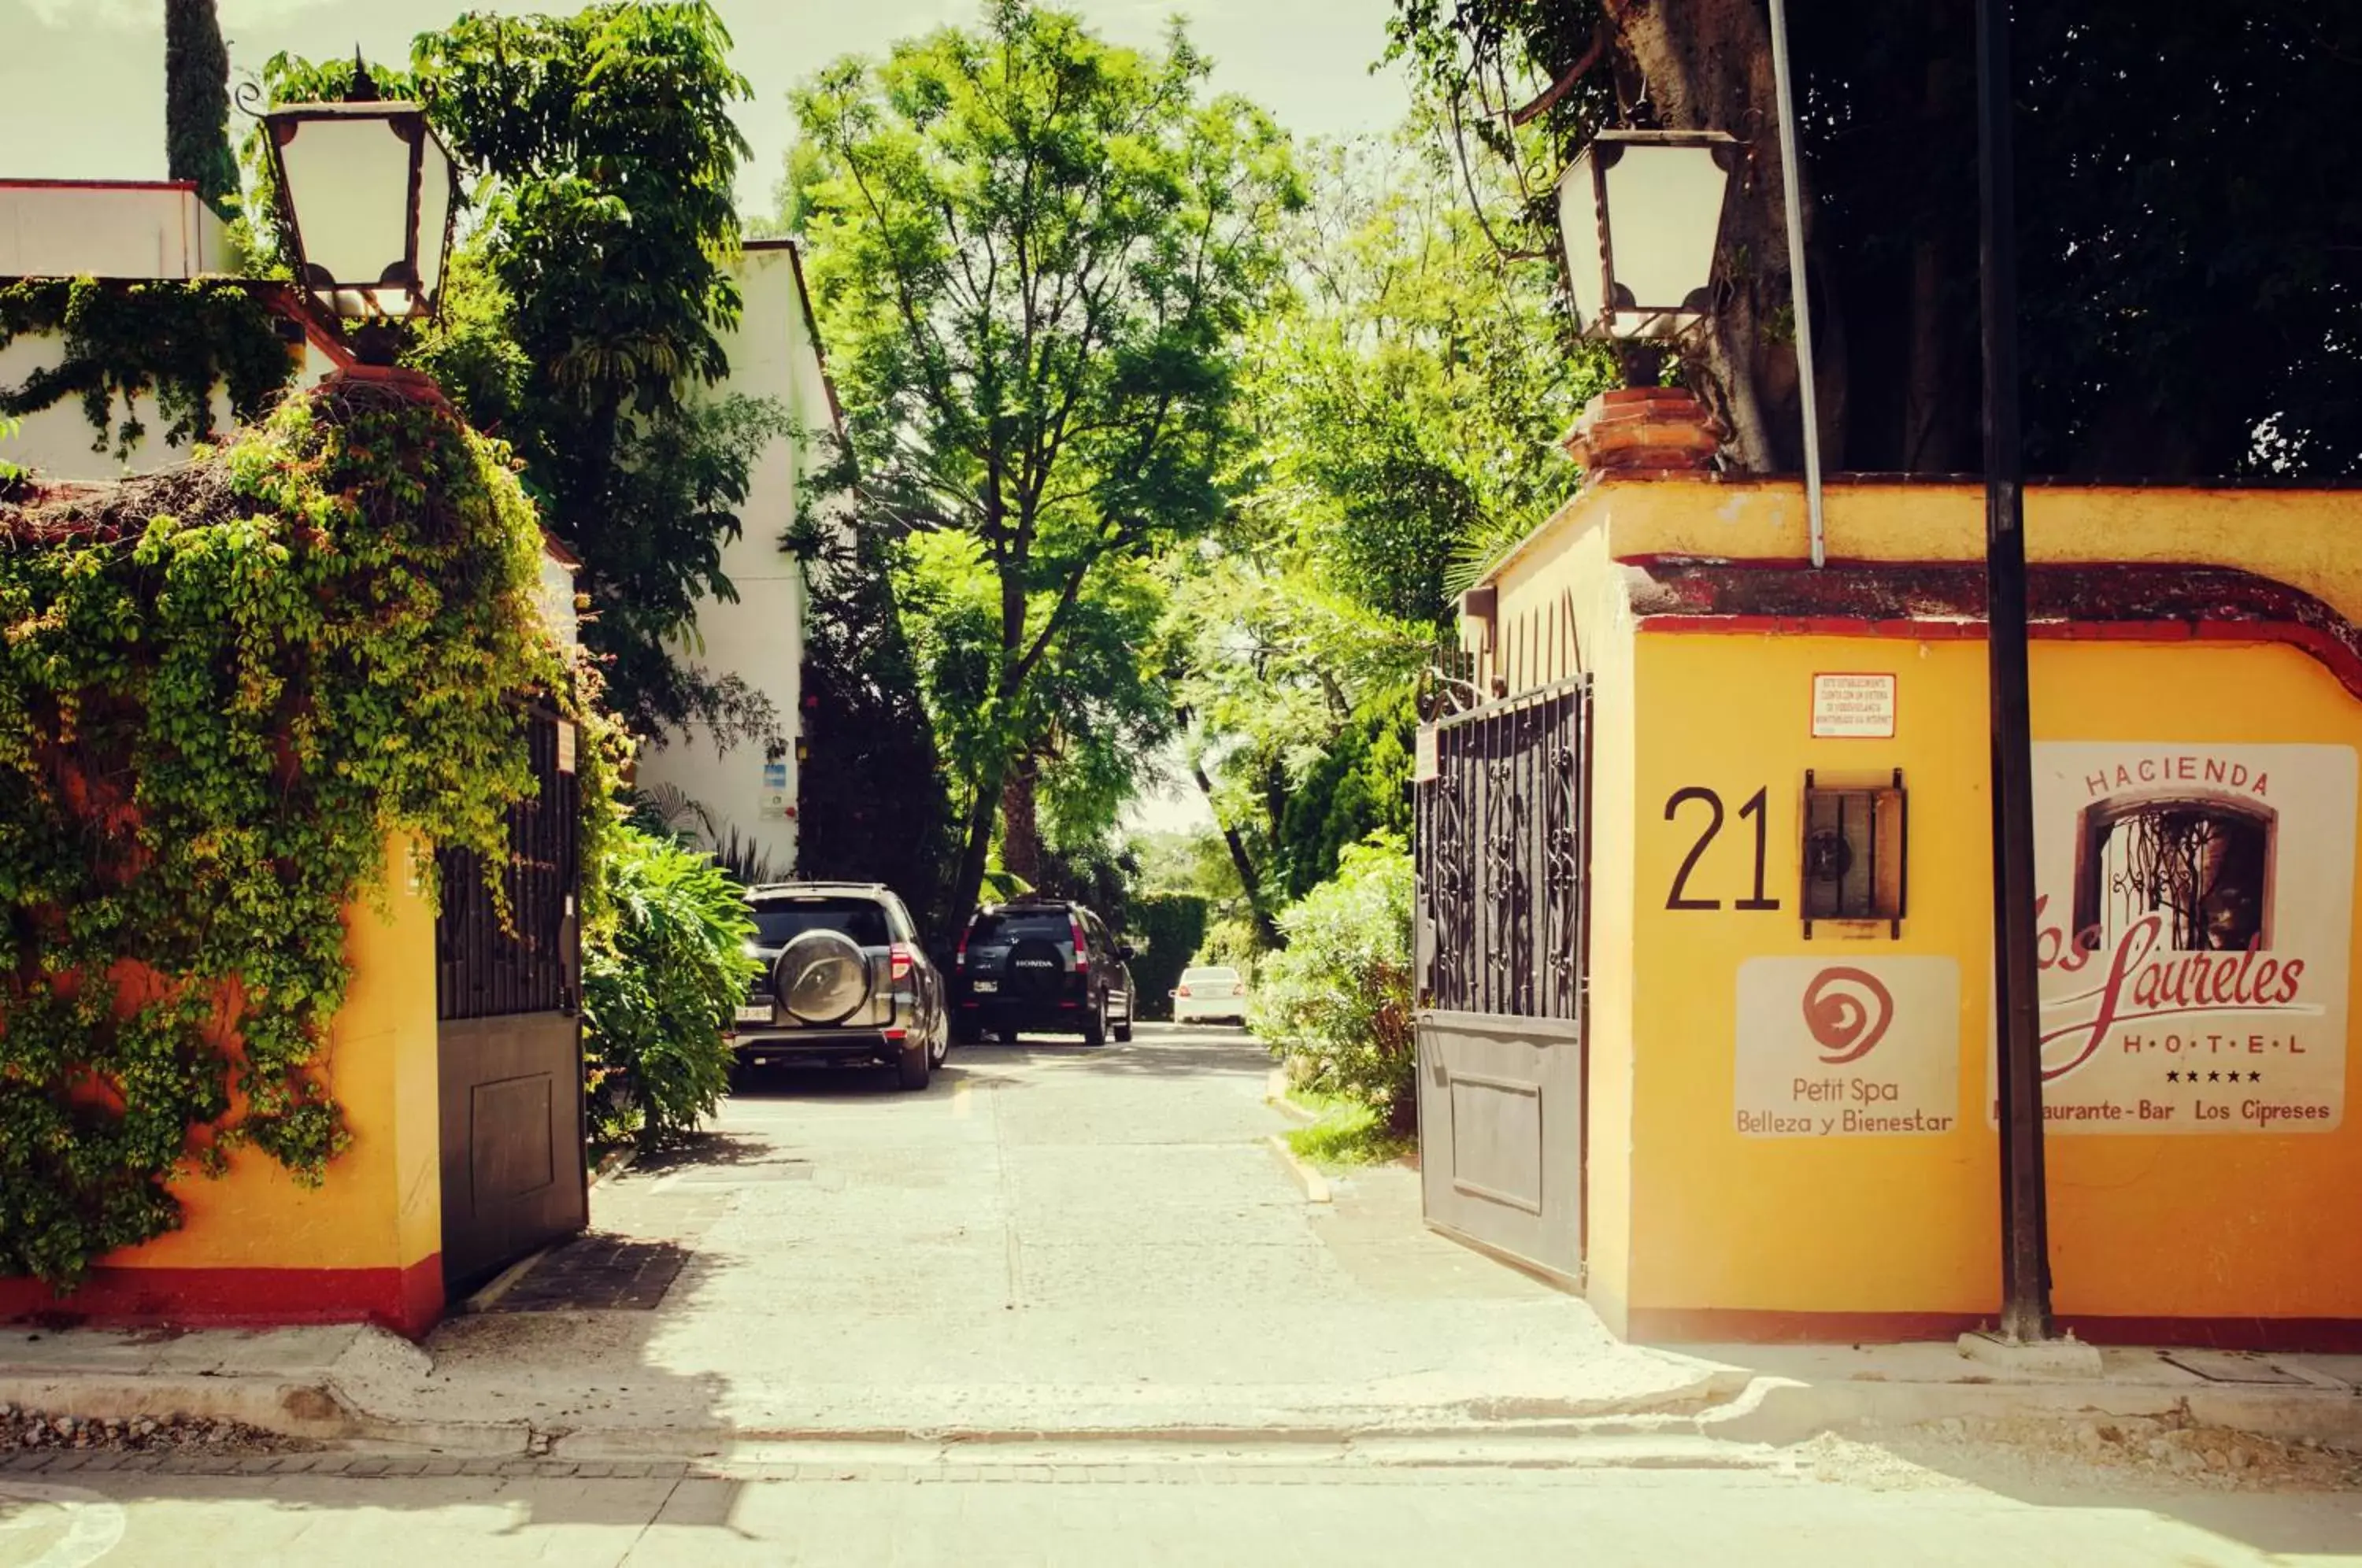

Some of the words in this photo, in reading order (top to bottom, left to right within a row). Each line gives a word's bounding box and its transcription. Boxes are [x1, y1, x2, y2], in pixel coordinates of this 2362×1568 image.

[2085, 756, 2269, 796] HACIENDA
[1664, 785, 1780, 910] 21
[2036, 894, 2103, 972] os
[1015, 959, 1054, 967] HONDA
[1793, 1078, 1846, 1101] Petit
[1851, 1078, 1899, 1105] Spa
[1737, 1110, 1812, 1133] Belleza
[1819, 1118, 1835, 1136] y
[1843, 1108, 1953, 1132] Bienestar
[2195, 1100, 2231, 1120] Los
[2242, 1100, 2331, 1128] Cipreses
